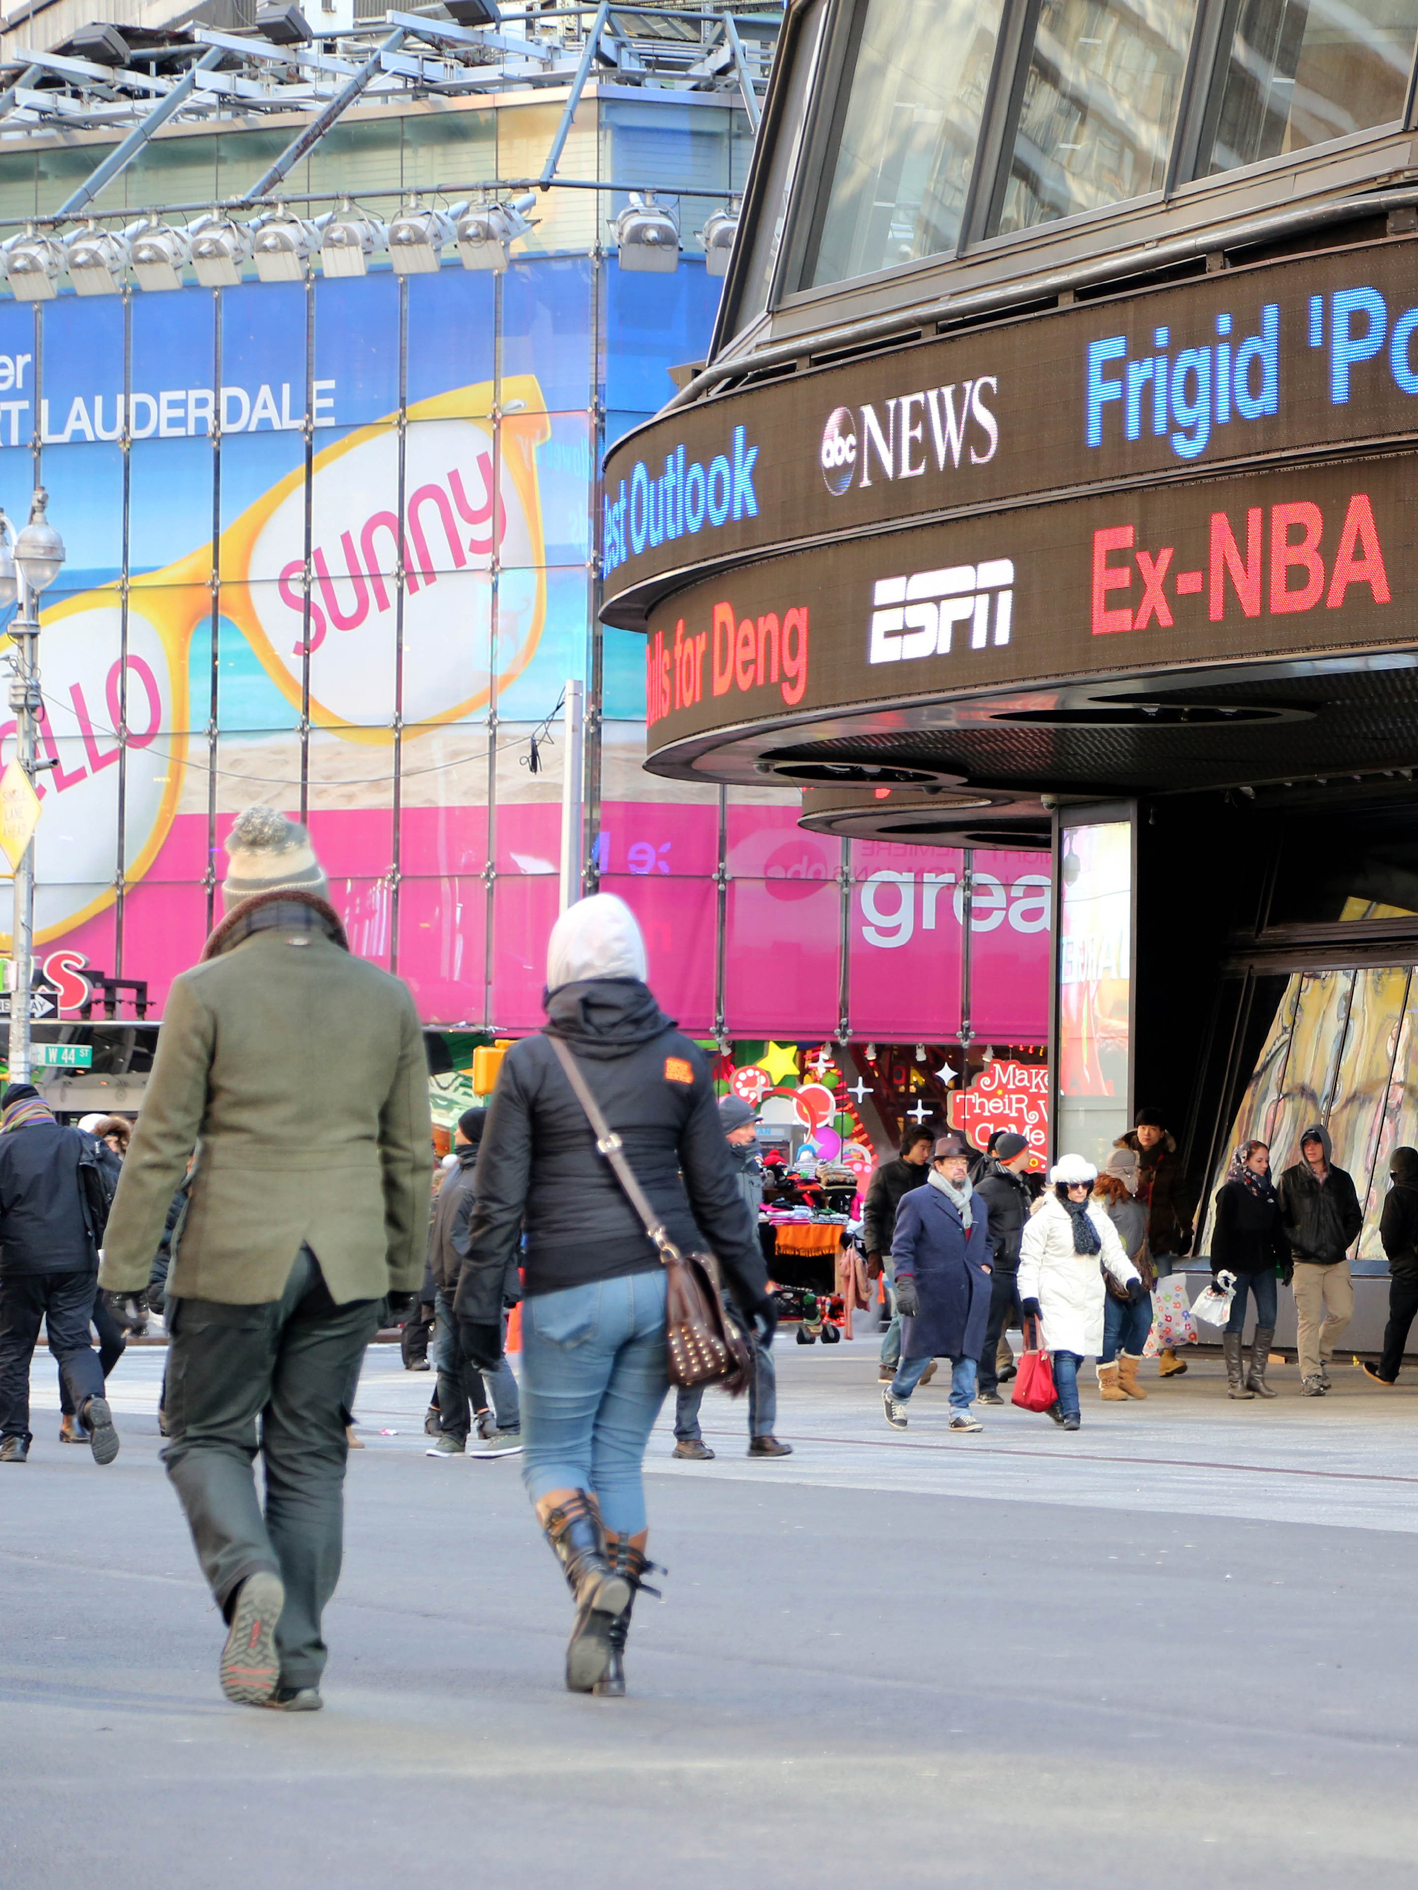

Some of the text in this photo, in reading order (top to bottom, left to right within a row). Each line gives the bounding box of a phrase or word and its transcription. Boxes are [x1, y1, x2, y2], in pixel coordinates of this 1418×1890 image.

[0, 379, 336, 447] T LAUDERDALE
[859, 374, 999, 489] NEWS
[1086, 304, 1280, 459] Frigid
[629, 415, 759, 554] Outlook
[869, 557, 1015, 665] ESPN
[1091, 493, 1392, 635] Ex-NBA
[672, 618, 708, 710] for
[711, 601, 809, 705] Deng
[860, 870, 1052, 948] grea
[48, 1047, 89, 1064] W 44 ST
